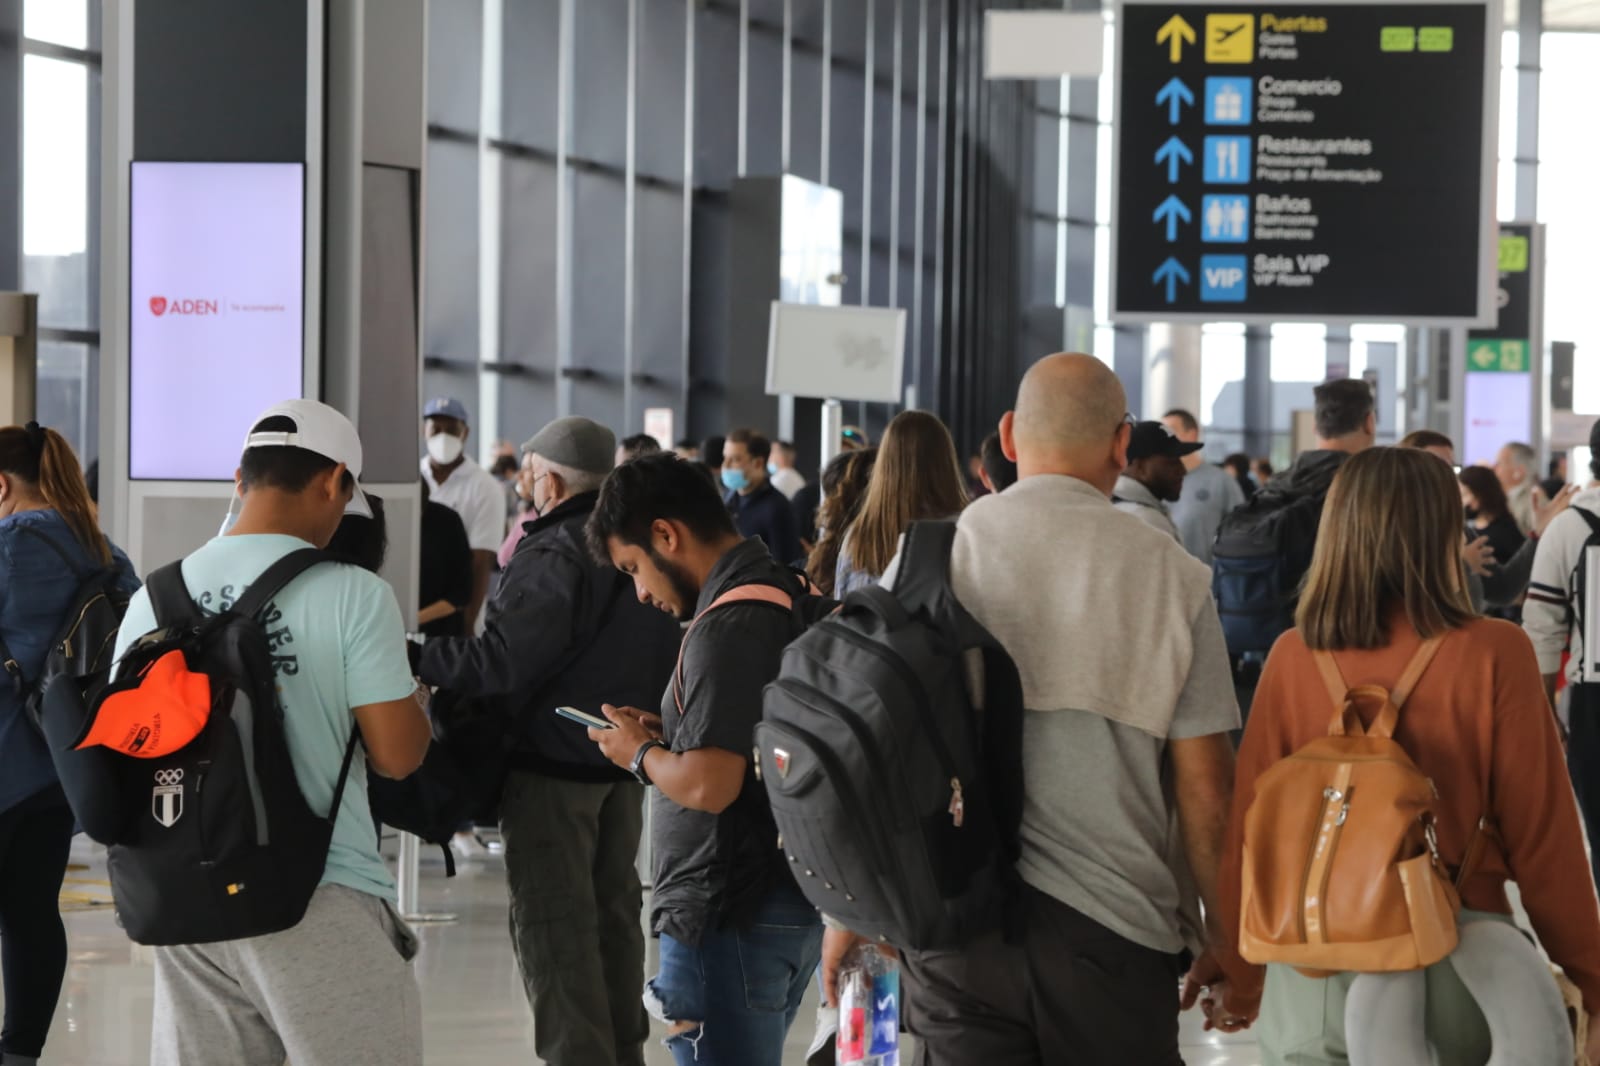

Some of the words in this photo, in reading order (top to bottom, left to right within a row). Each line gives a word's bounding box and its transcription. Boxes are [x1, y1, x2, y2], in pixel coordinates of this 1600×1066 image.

[1260, 14, 1328, 32] Puertas
[1258, 76, 1342, 96] Comercio
[1258, 135, 1372, 155] Restaurantes
[1256, 194, 1312, 213] Baños
[1253, 253, 1293, 273] Sala
[1295, 254, 1329, 273] VIP
[1205, 267, 1243, 288] VIP
[169, 299, 218, 315] ADEN
